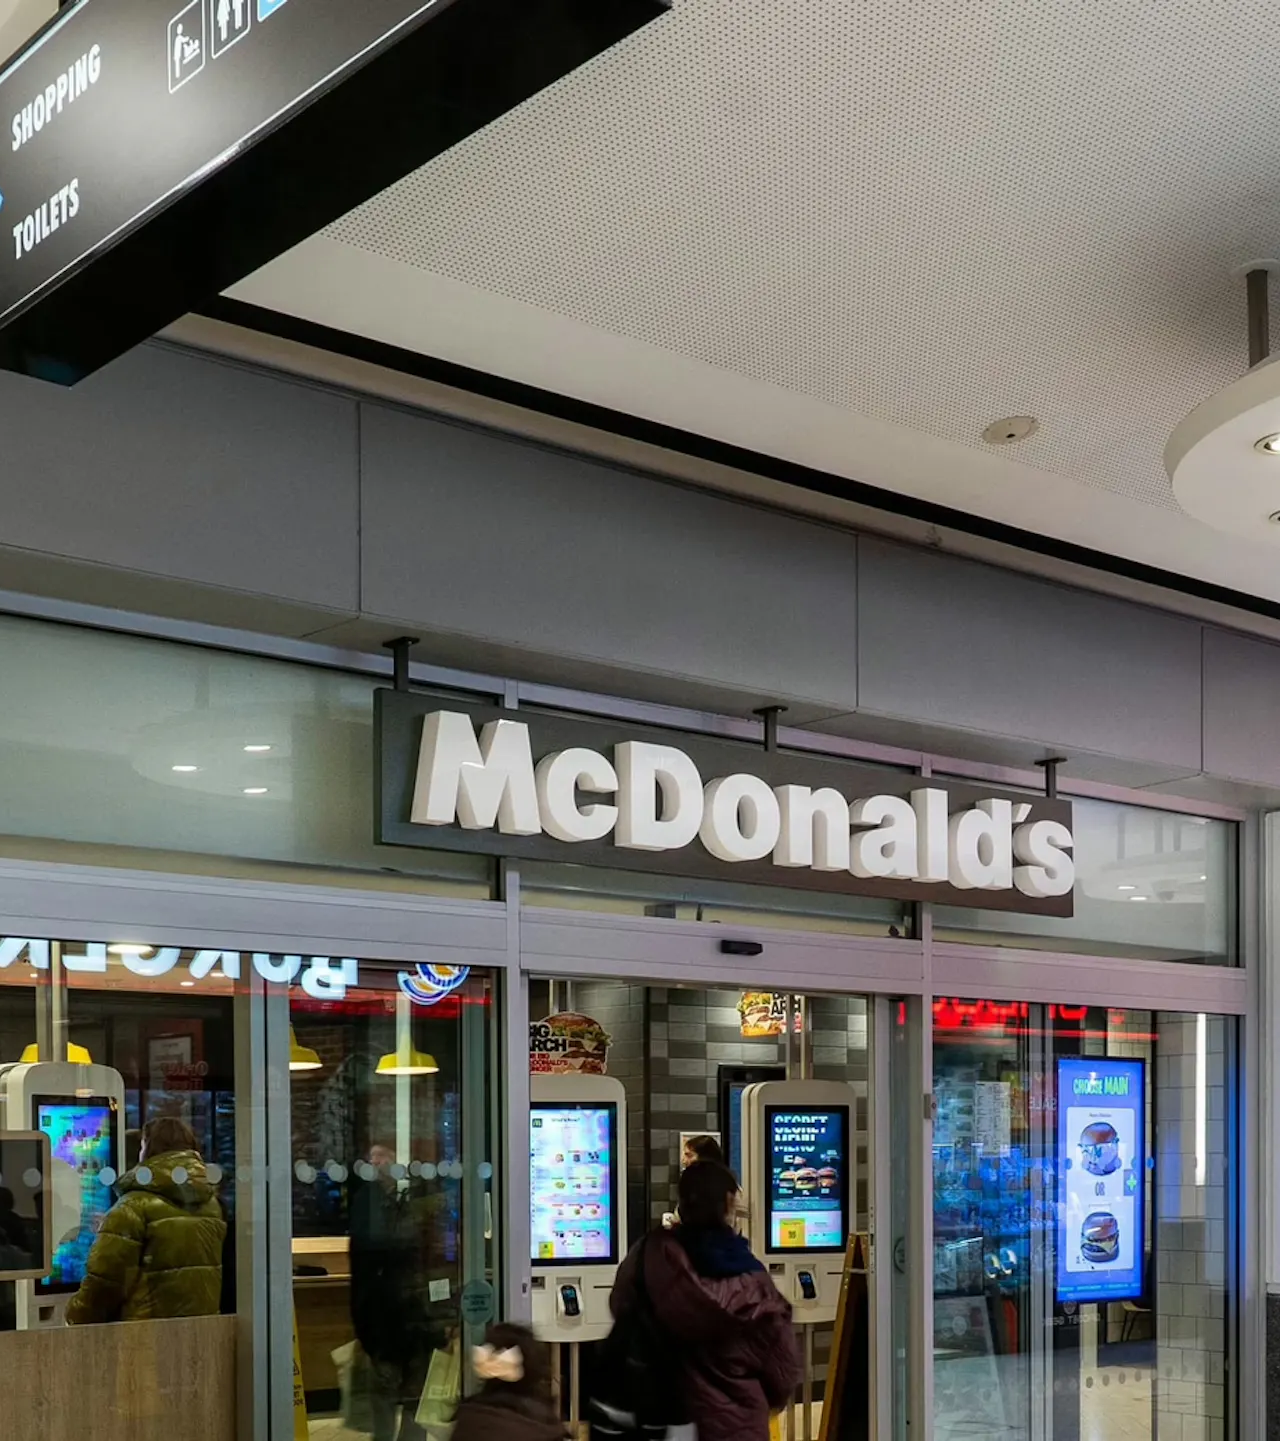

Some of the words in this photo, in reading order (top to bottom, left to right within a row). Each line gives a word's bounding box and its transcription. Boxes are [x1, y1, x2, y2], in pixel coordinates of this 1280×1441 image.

[11, 43, 101, 151] SHOPPING
[13, 177, 80, 260] TOILETS
[410, 709, 1075, 899] McDonald's
[530, 1039, 567, 1052] RCH
[1073, 1077, 1104, 1096] CHOOSE
[1104, 1075, 1130, 1095] MAIN
